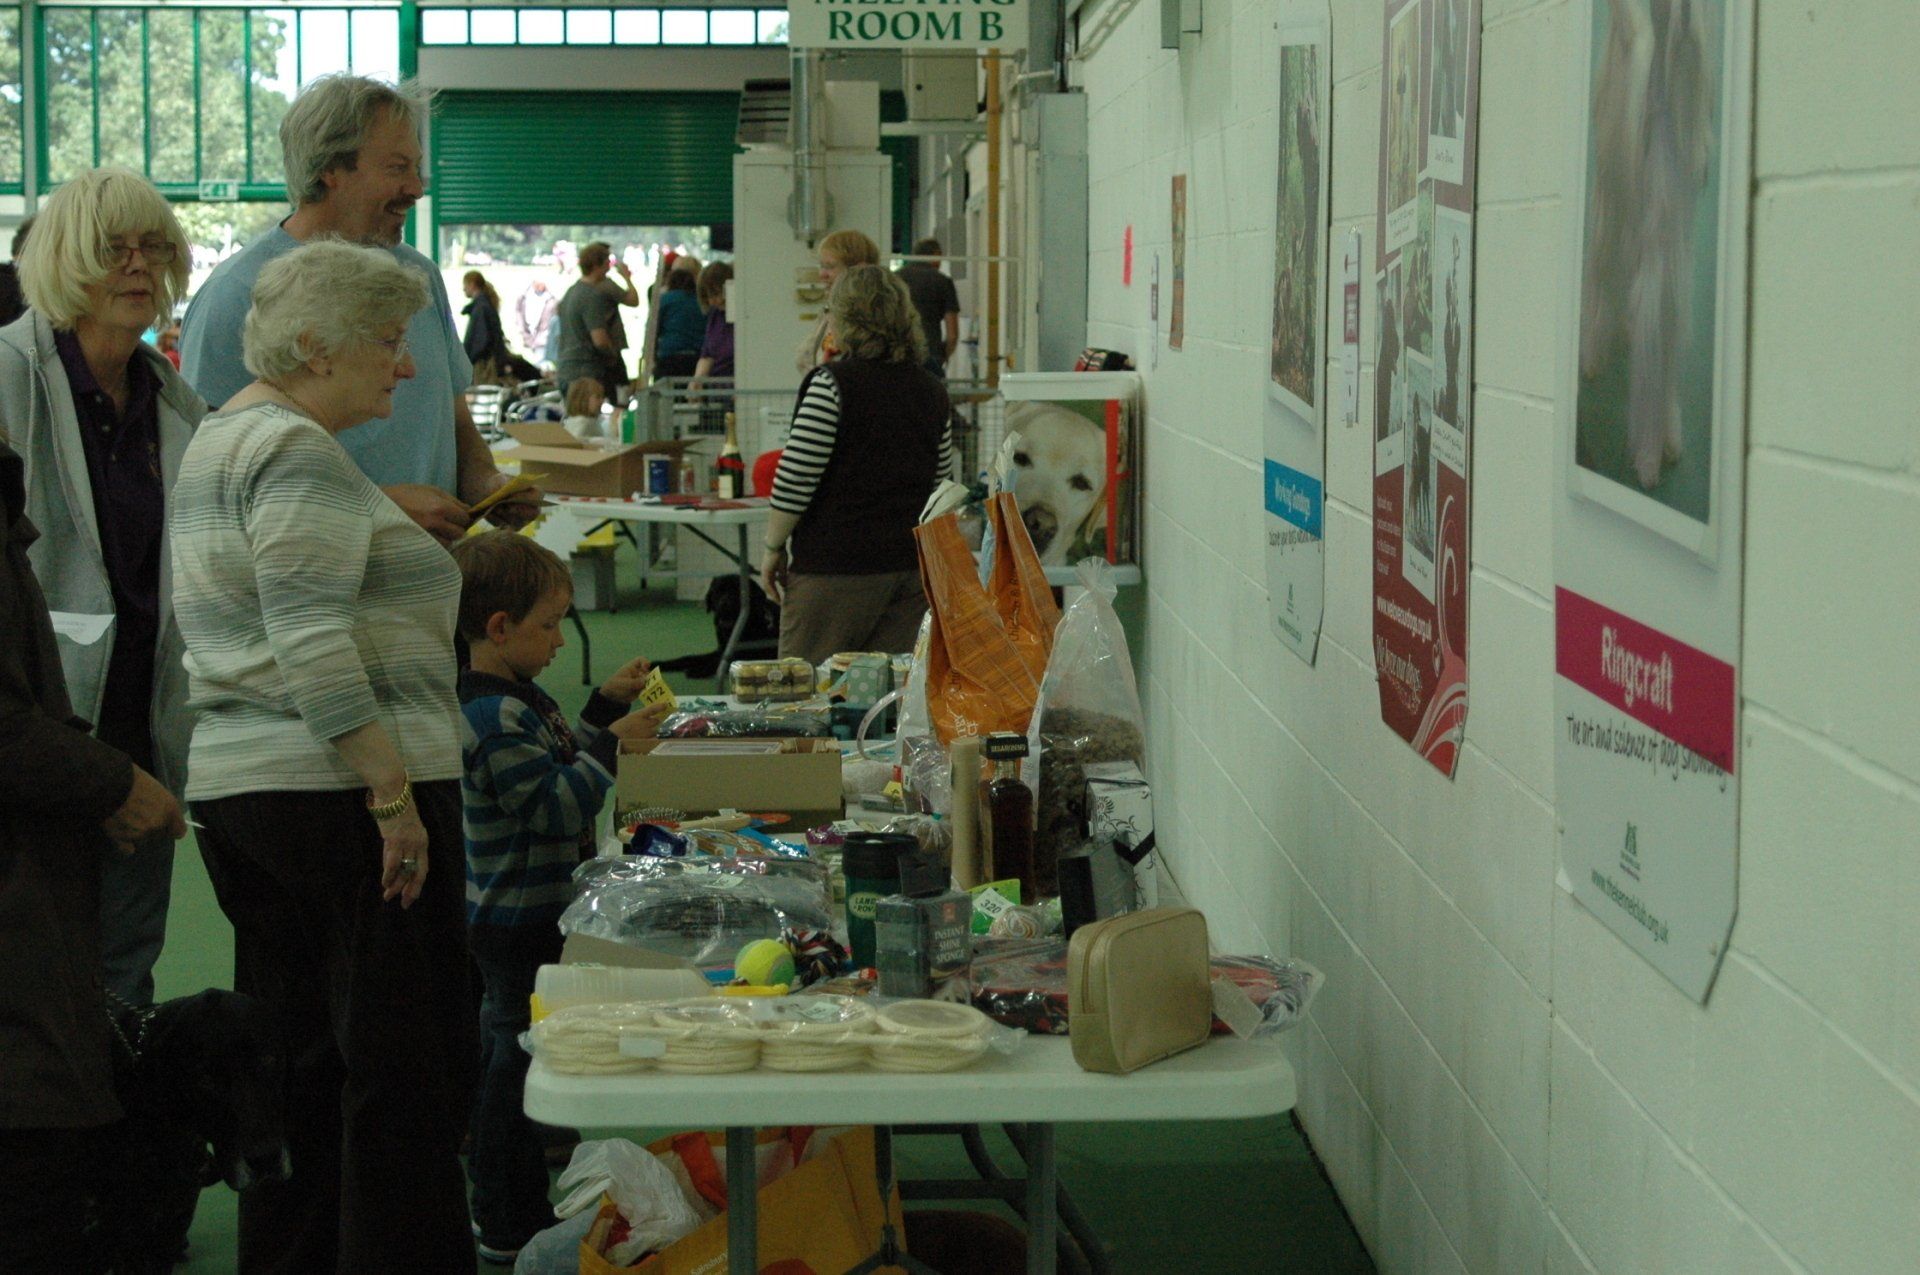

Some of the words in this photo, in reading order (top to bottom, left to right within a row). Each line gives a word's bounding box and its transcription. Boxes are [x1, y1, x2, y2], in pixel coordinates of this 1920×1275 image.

[829, 11, 962, 41] ROOM
[980, 11, 1003, 41] B
[1601, 622, 1672, 714] Ringcraft
[646, 686, 666, 703] 172
[1567, 711, 1580, 746] The
[1582, 716, 1594, 748] art
[1596, 717, 1612, 751] and
[1648, 726, 1659, 776] of
[980, 899, 1002, 914] 320
